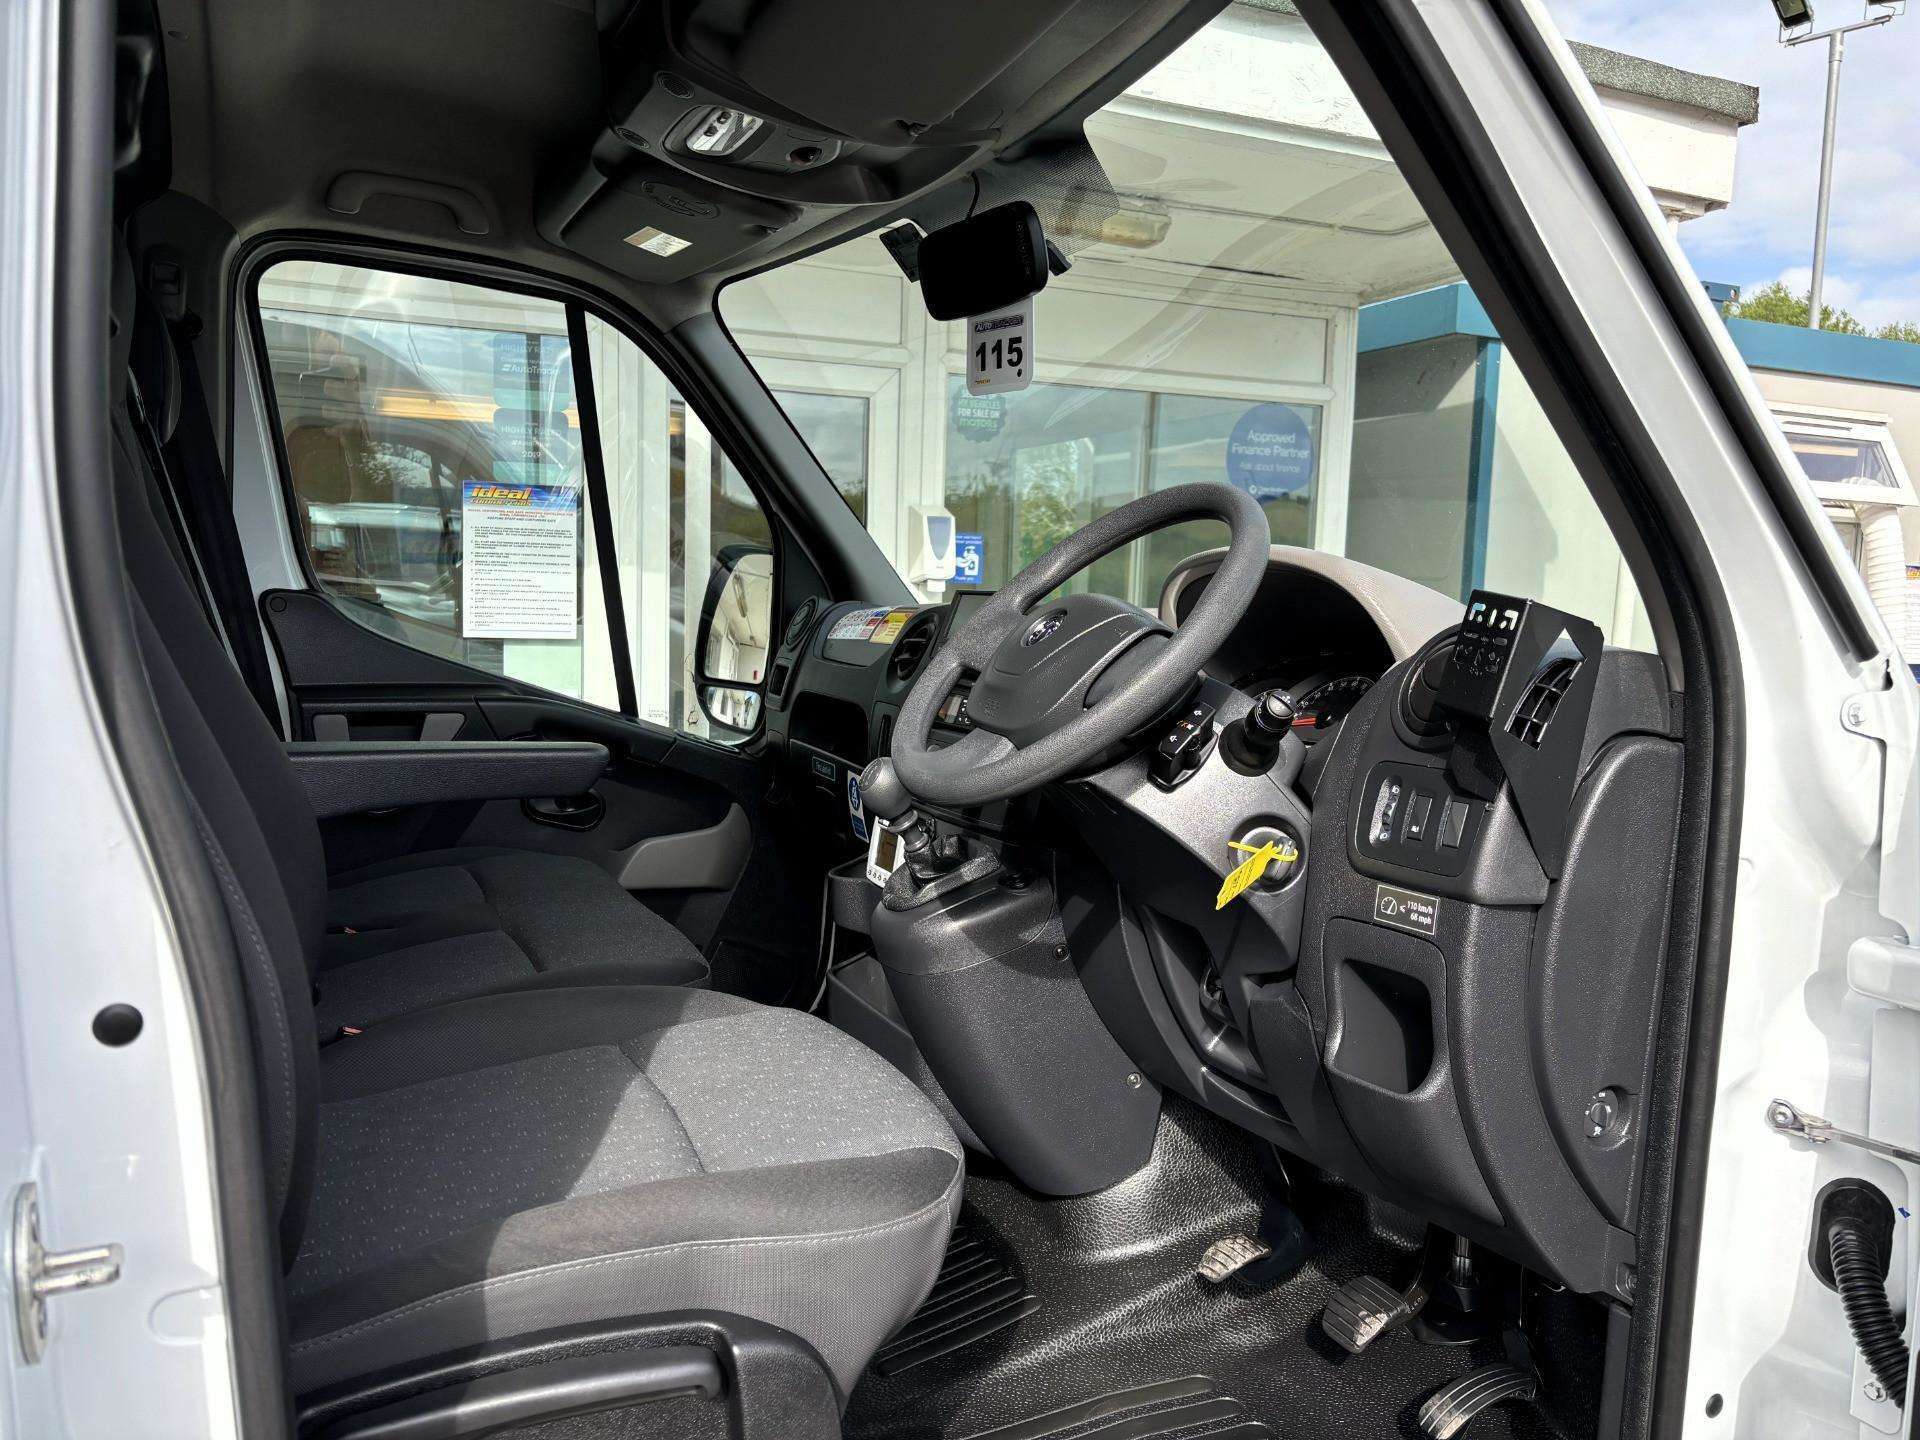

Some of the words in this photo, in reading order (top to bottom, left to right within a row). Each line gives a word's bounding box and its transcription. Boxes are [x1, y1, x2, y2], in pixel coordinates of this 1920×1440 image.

[975, 336, 1023, 372] 115
[958, 408, 971, 416] FOR
[972, 409, 989, 418] SALE
[1248, 429, 1296, 443] Approved
[1232, 443, 1272, 456] Finance
[1273, 445, 1310, 459] Partner
[1407, 900, 1418, 911] 110
[1418, 903, 1433, 915] km/h
[1410, 912, 1418, 921] 68
[1419, 916, 1432, 925] mph
